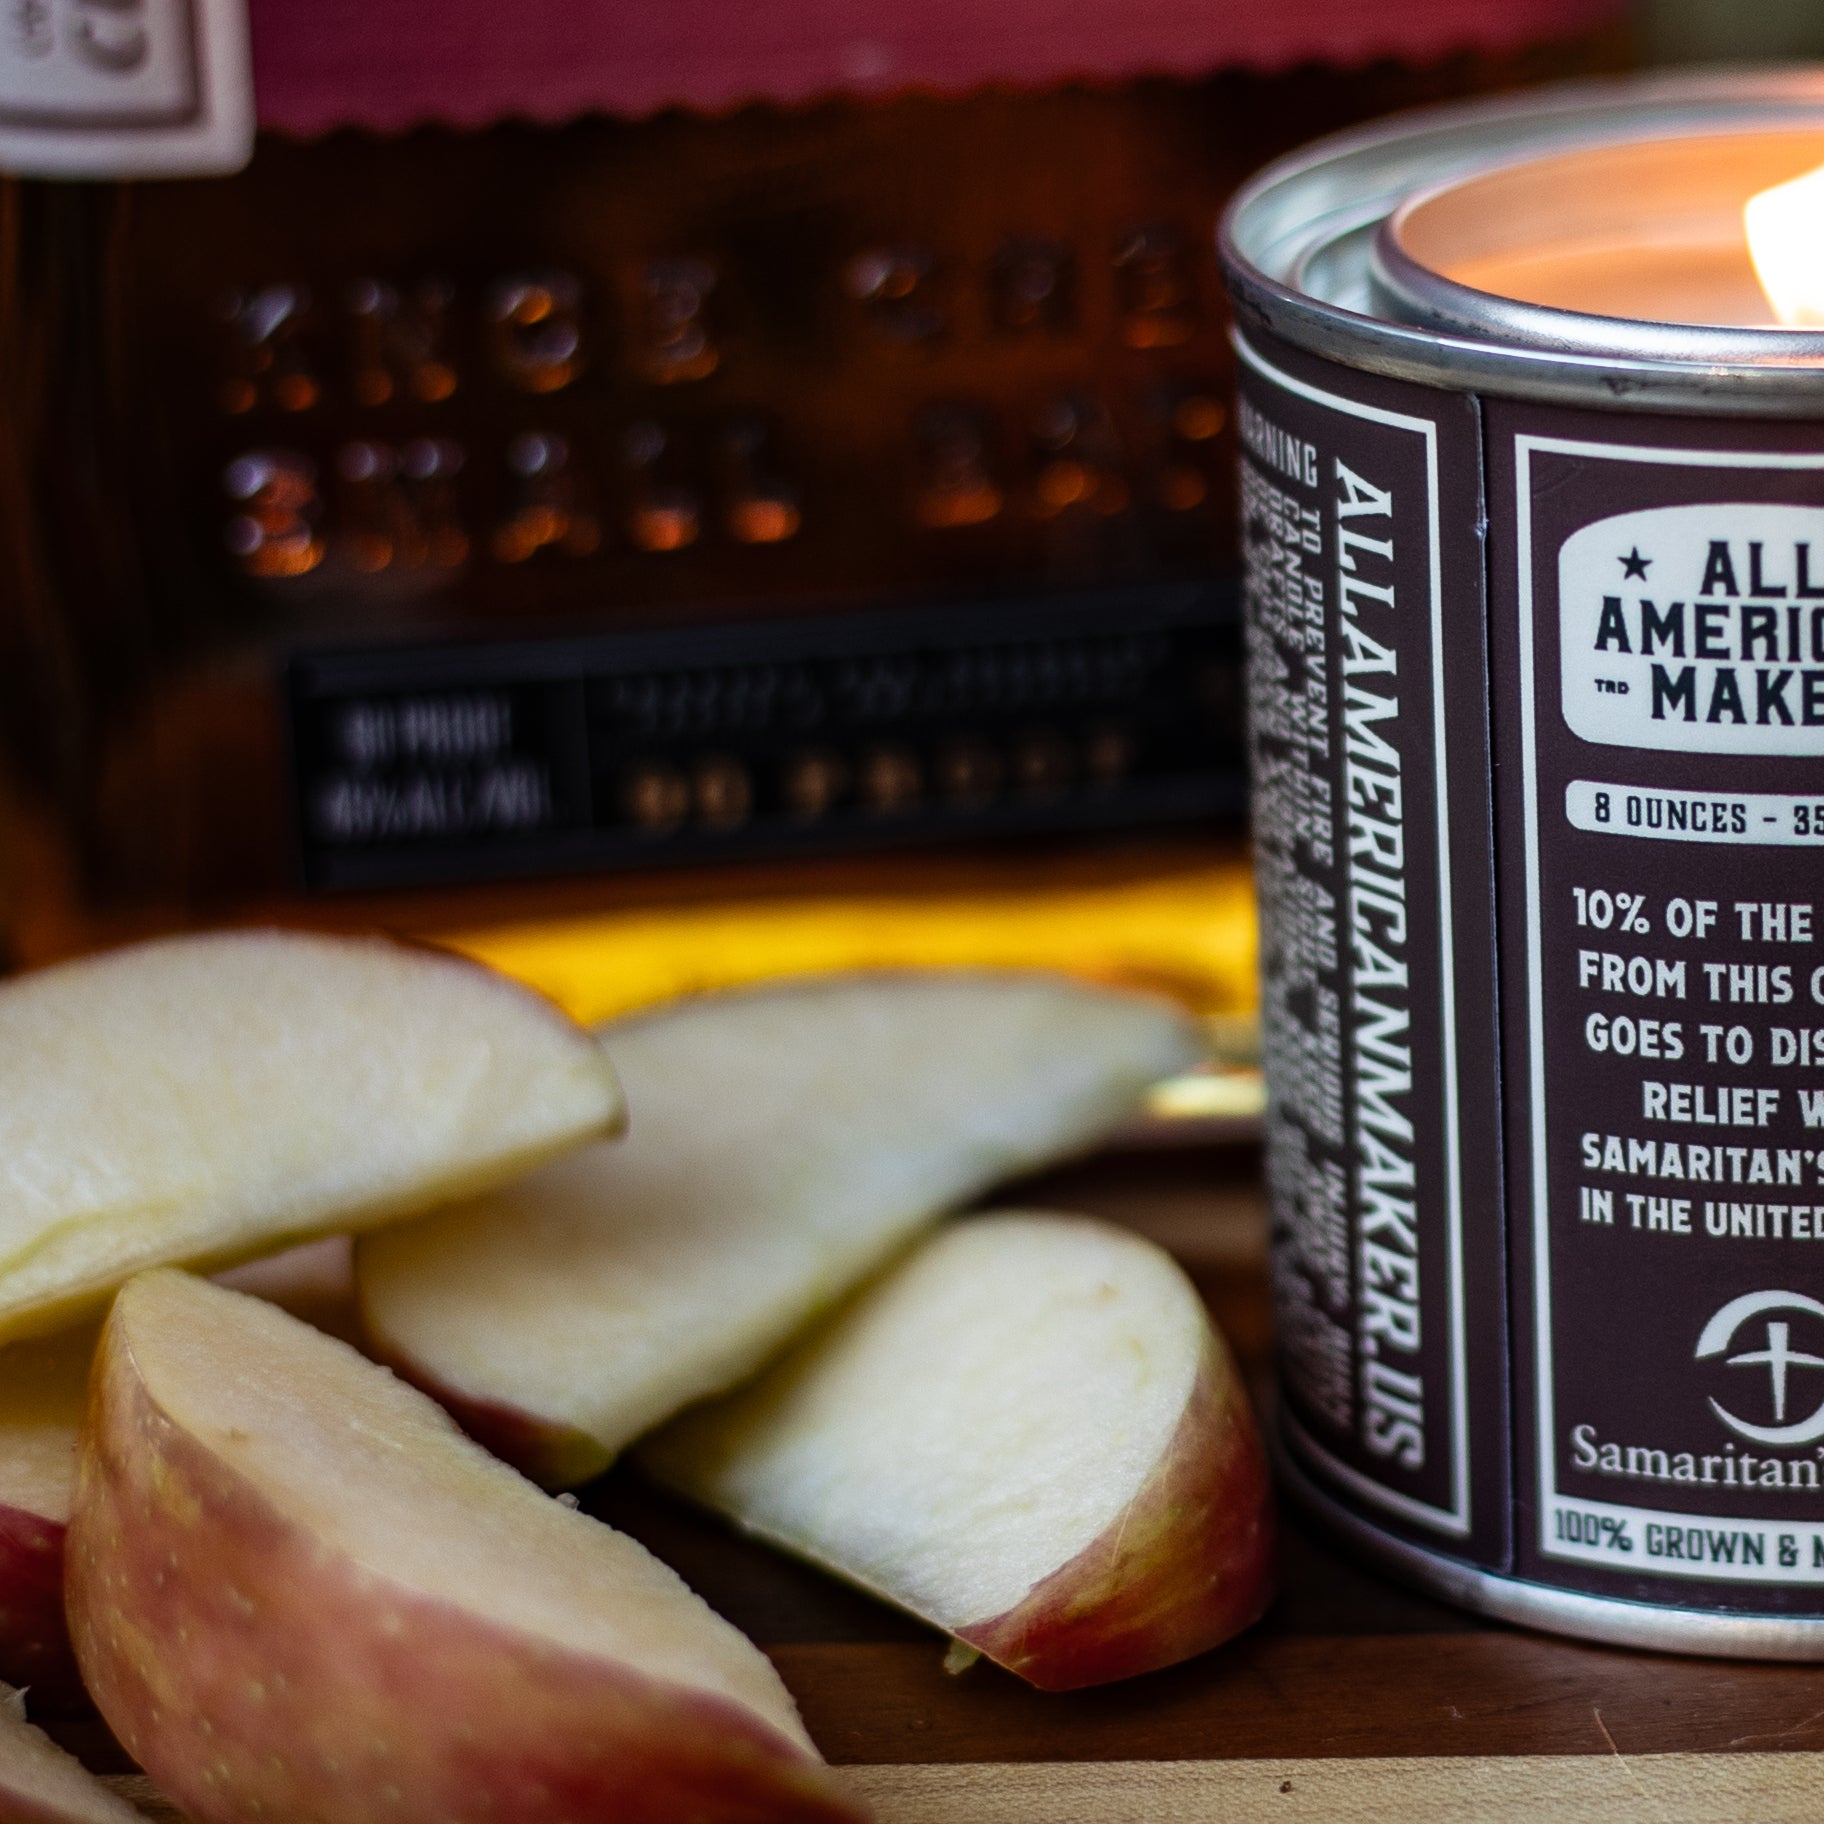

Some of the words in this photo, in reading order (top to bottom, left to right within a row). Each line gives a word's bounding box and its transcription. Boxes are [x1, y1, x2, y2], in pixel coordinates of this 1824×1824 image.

[1238, 398, 1318, 489] RNING
[1301, 507, 1322, 555] TO
[1283, 495, 1305, 652] CANDLE
[1303, 574, 1330, 759] PREVENT
[1594, 678, 1631, 695] TRD
[1309, 773, 1335, 867] FIRE
[1594, 792, 1611, 824] 8
[1626, 795, 1748, 834] OUNCES
[1313, 882, 1338, 972] AND
[1573, 887, 1651, 935] 10%
[1665, 898, 1719, 939] OF
[1735, 903, 1814, 942] THE
[1335, 457, 1425, 1470] ALLAMERICANMAKER.US
[1578, 950, 1688, 1000] FROM
[1702, 962, 1794, 1005] THIS
[1317, 984, 1346, 1147] SERIOUS
[1584, 1012, 1685, 1061] GOES
[1700, 1024, 1754, 1065] TO
[1642, 1080, 1781, 1128] RELIEF
[1580, 1186, 1614, 1225] IN
[1626, 1193, 1692, 1233] THE
[1554, 1508, 1634, 1553] 100%
[1645, 1523, 1766, 1566] GROWN
[1777, 1535, 1799, 1566] &
